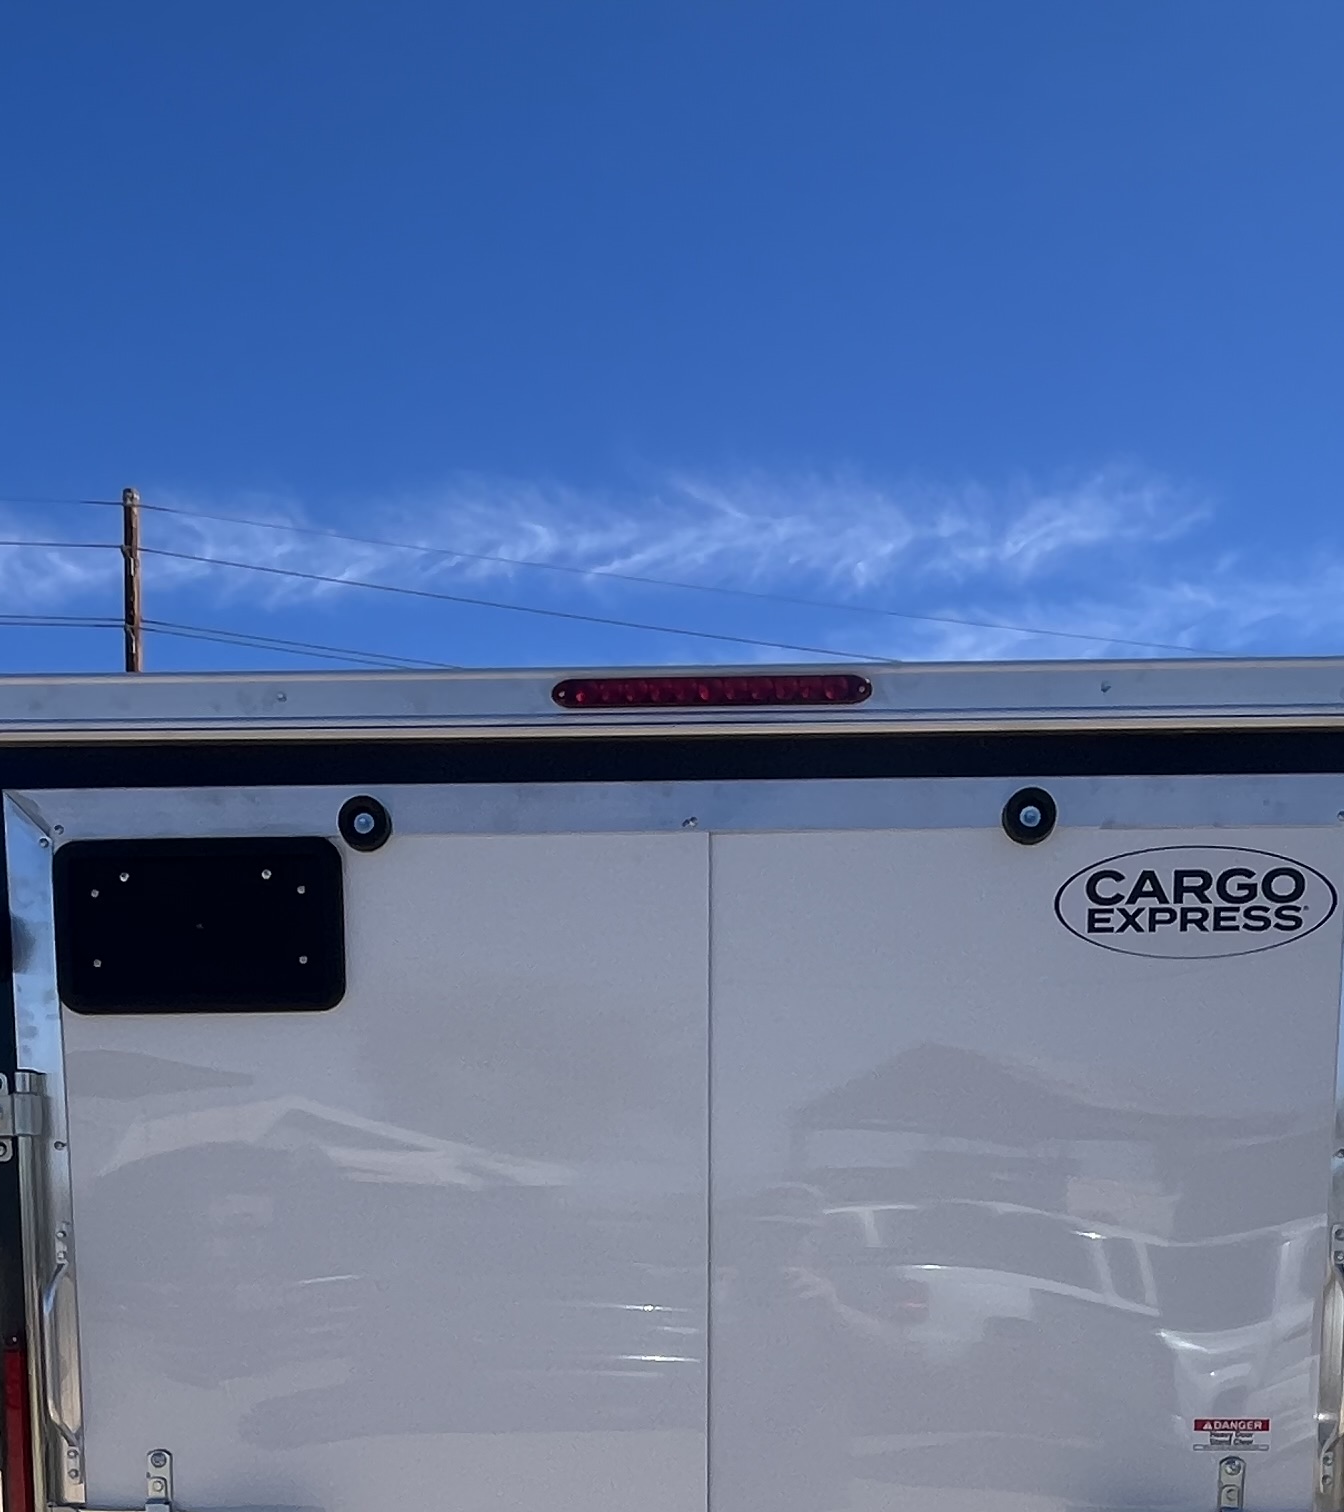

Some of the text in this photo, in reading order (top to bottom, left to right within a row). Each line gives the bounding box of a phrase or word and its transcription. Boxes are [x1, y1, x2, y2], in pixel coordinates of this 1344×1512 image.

[1085, 866, 1306, 905] CARGO
[1086, 905, 1304, 934] EXPRESS
[1213, 1420, 1263, 1430] DANGER
